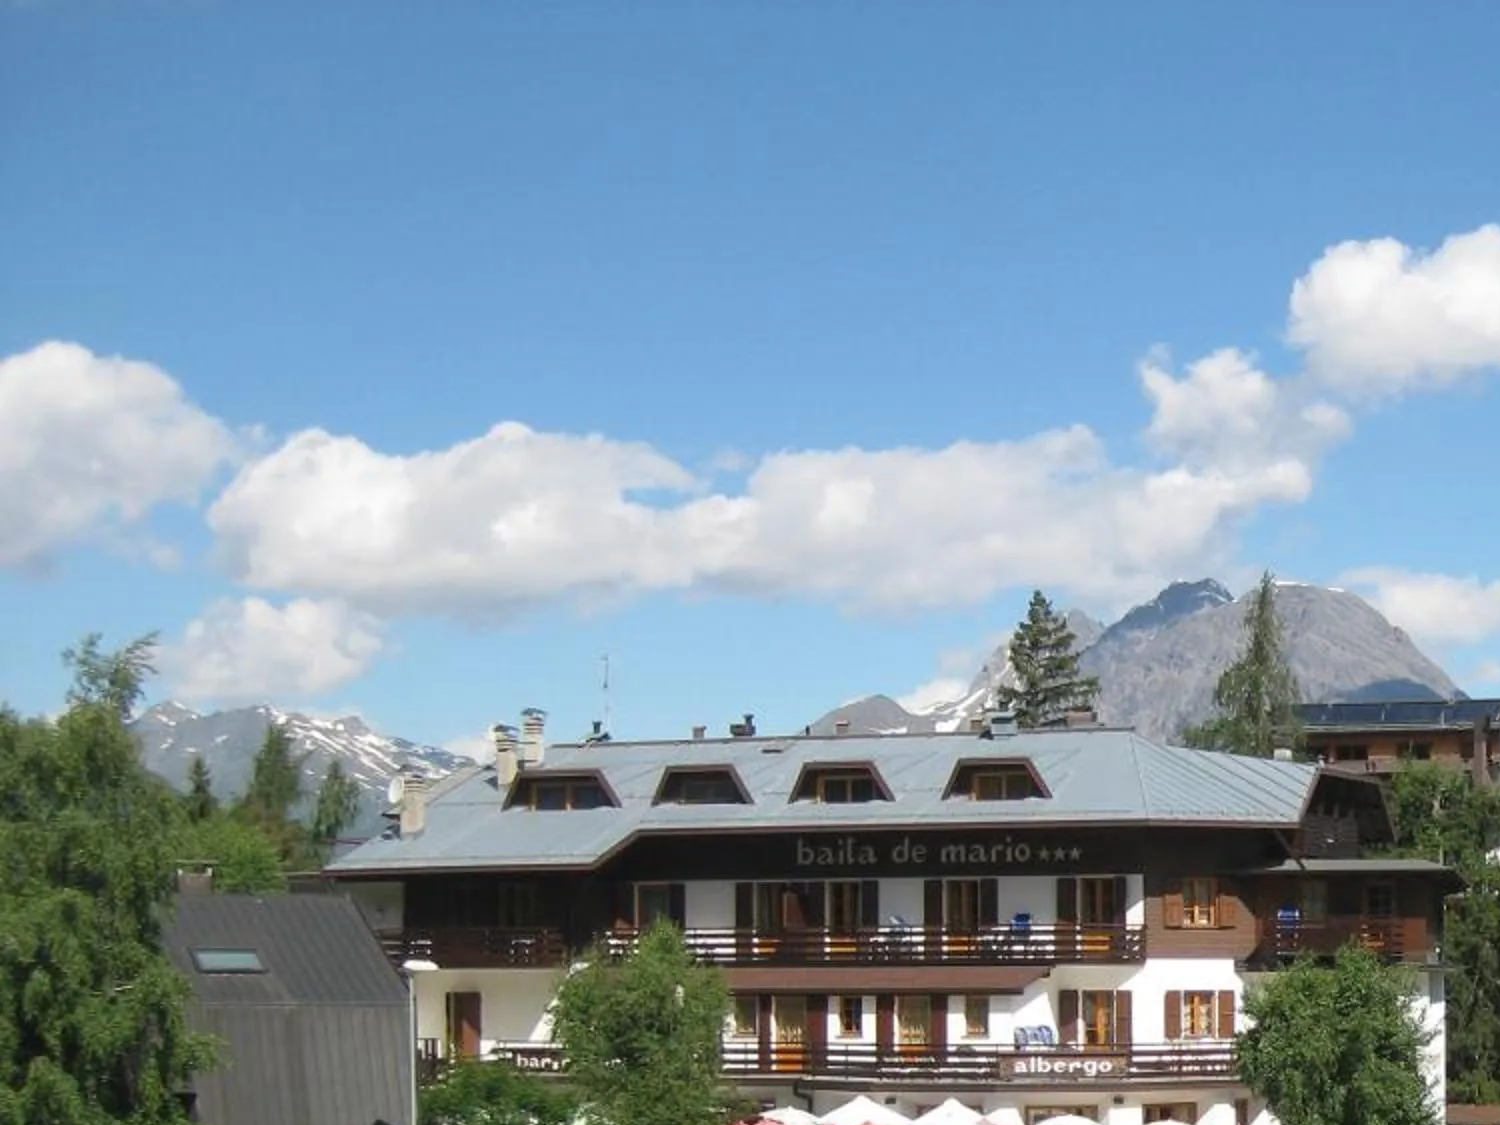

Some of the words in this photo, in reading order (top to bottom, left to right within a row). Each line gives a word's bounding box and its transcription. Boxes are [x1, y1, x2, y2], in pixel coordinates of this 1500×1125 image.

[891, 836, 928, 864] de
[940, 836, 1031, 864] mario
[1013, 1056, 1113, 1077] albergo
